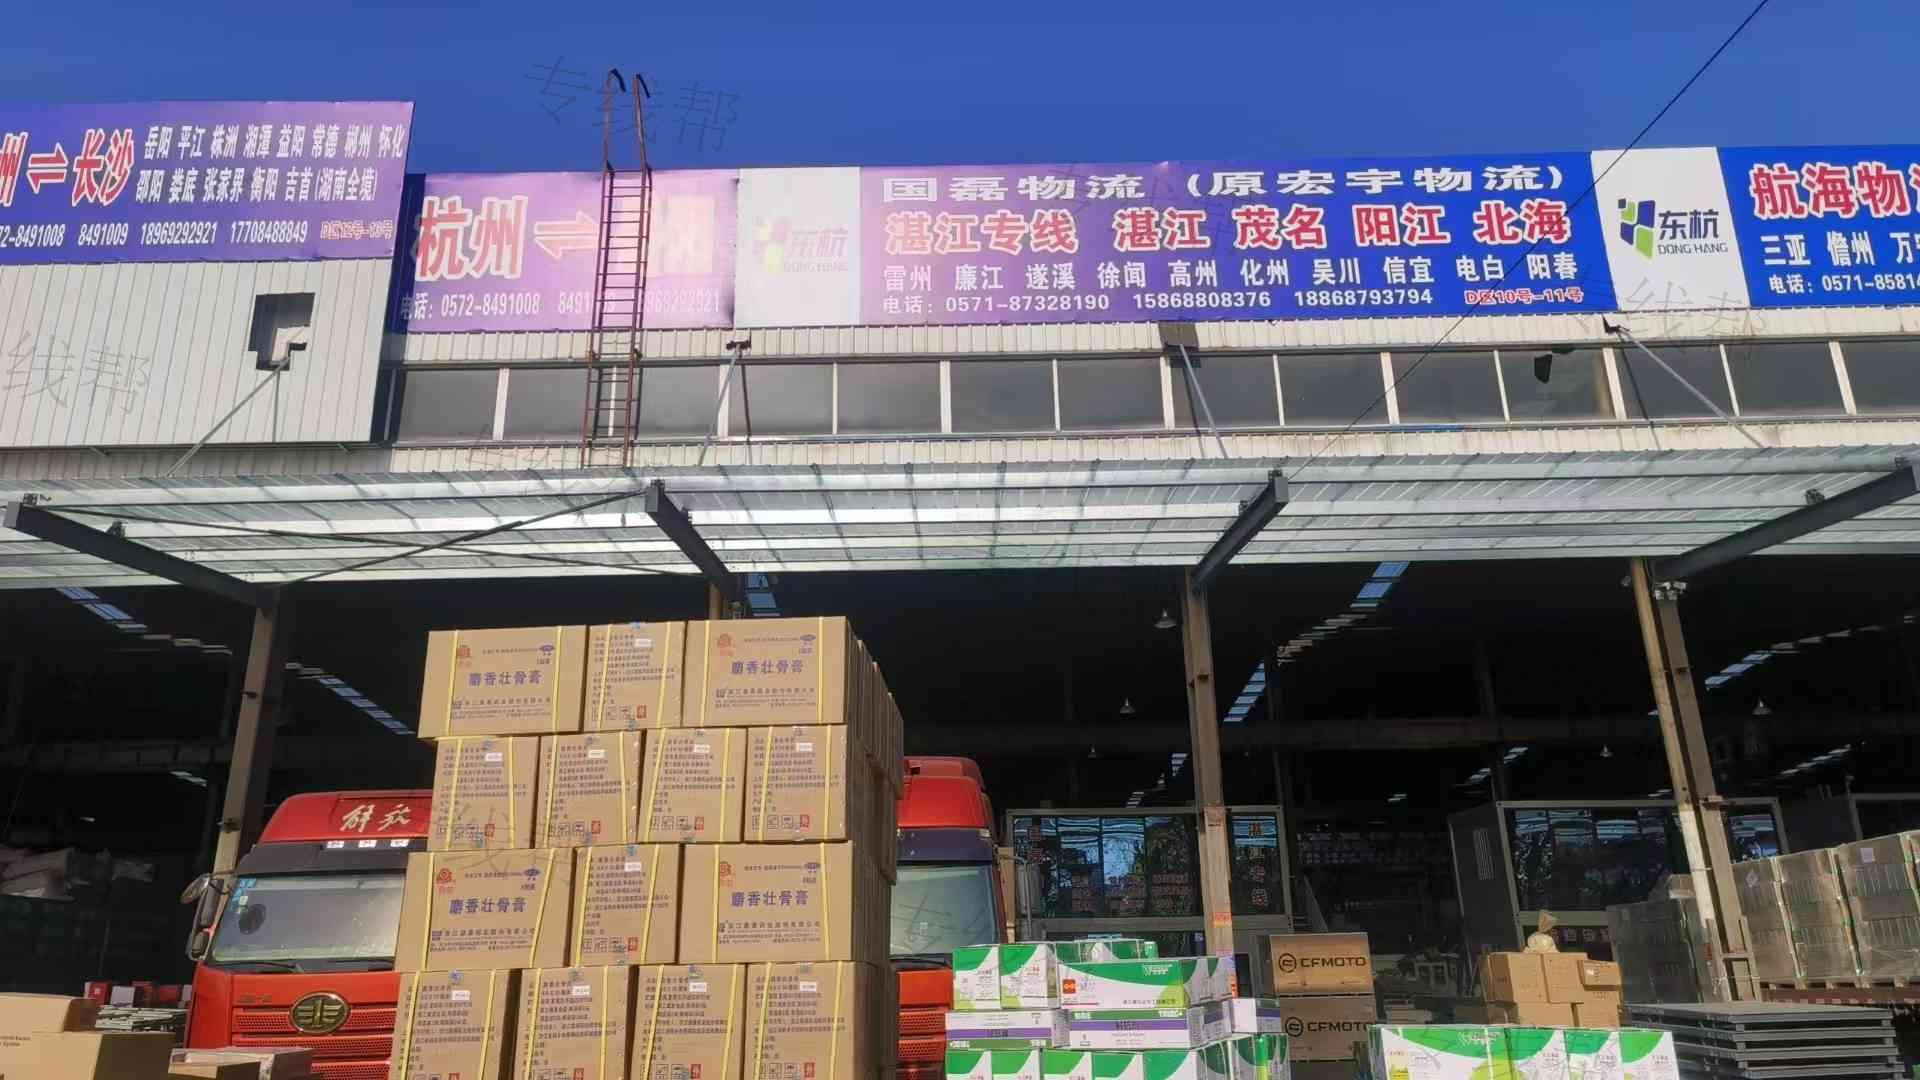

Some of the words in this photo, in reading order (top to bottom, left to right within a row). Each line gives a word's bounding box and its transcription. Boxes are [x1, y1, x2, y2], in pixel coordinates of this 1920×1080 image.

[144, 125, 173, 160] 岳阳
[178, 125, 206, 160] 平江
[210, 124, 239, 160] 株洲
[276, 124, 306, 158] 益阳
[377, 124, 406, 159] 怀化
[72, 128, 135, 208] 长沙
[135, 168, 165, 203] 邵阳
[168, 167, 199, 204] 娄底
[203, 167, 245, 203] 张家界
[250, 166, 279, 203] 衡阳
[78, 222, 129, 247] 8491009
[140, 221, 217, 246] 18969292921
[230, 220, 309, 244] 17708488849
[412, 195, 528, 282] 杭州
[884, 208, 1079, 256] 湛江专线
[1112, 205, 1211, 252] 湛江
[1231, 203, 1328, 250] 茂名
[1352, 201, 1451, 248] 阳江
[1473, 199, 1572, 245] 北海
[1658, 208, 1720, 240] 东杭
[1658, 243, 1692, 256] DONG
[1693, 241, 1729, 255] HANG
[1760, 233, 1812, 266] 三亚
[1826, 231, 1876, 267] 儋州
[883, 265, 933, 293] 雷州
[954, 263, 1005, 291] 廉江
[1025, 262, 1076, 290] 遂溪
[1097, 261, 1147, 289] 徐闻
[1167, 259, 1218, 288] 高州
[1239, 258, 1290, 287] 化州
[1312, 256, 1361, 286] 吴川
[1383, 255, 1435, 285] 信宜
[1455, 253, 1505, 281] 电白
[1526, 251, 1578, 280] 阳春
[441, 292, 541, 318] 0572-8491008
[944, 293, 1110, 313] 0571-87328190
[1132, 289, 1271, 310] 15868808376
[1294, 287, 1433, 308] 18868793794
[1300, 957, 1367, 968] CFMOTO
